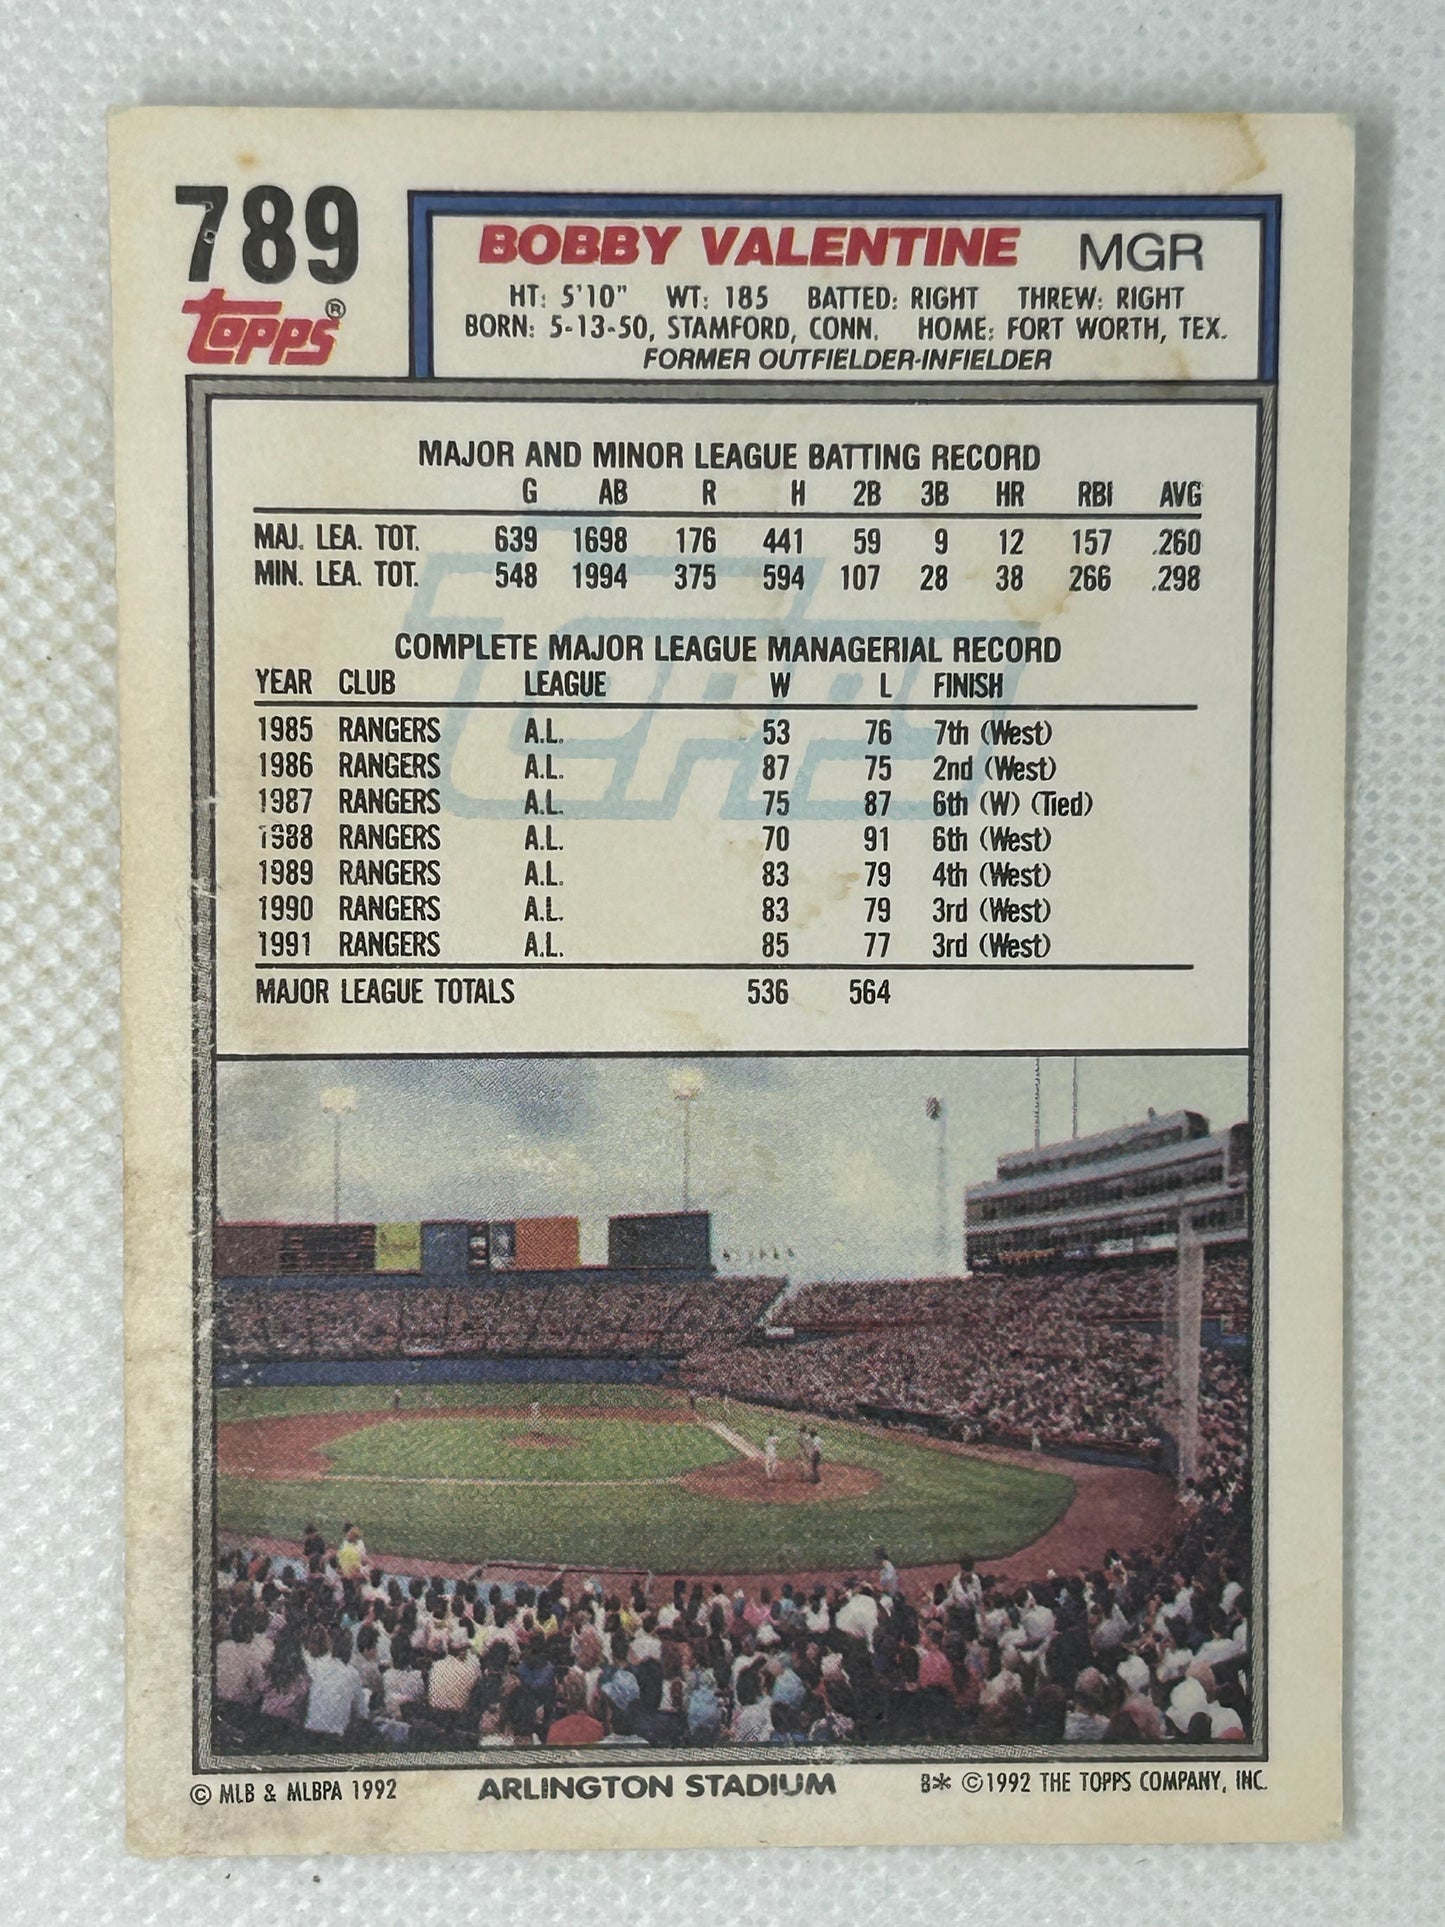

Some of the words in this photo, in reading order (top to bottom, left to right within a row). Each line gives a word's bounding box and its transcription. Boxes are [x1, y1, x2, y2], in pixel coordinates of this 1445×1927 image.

[175, 184, 359, 285] 789
[478, 223, 683, 266] BOBBY
[701, 226, 1022, 267] VALENTINE
[1079, 232, 1204, 272] MGR
[509, 283, 546, 308] HT:
[665, 284, 709, 310] WT:
[725, 285, 768, 310] 185
[807, 285, 898, 311] BATTED:
[911, 286, 979, 311] RIGHT
[1017, 286, 1103, 311] THREW:
[1116, 285, 1185, 311] RIGHT
[465, 313, 535, 338] BORN:
[549, 314, 655, 343] 5-13-50,
[667, 315, 797, 345] STAMFORD,
[809, 315, 878, 341] CONN.
[918, 316, 994, 341] HOME:
[1007, 316, 1065, 341] FORT
[1075, 316, 1167, 345] WORTH,
[1178, 316, 1228, 340] TEX.
[643, 347, 751, 370] FORMER
[758, 347, 1053, 371] OUTFIELDER-INFIELDER
[418, 439, 515, 468] MAJOR
[525, 441, 582, 468] AND
[593, 441, 684, 470] MINOR
[695, 442, 798, 470] LEAGUE
[808, 443, 921, 471] BATTING
[931, 443, 1041, 471] RECORD
[522, 477, 538, 505] G
[598, 478, 628, 506] AB
[702, 478, 717, 506] R
[791, 479, 806, 507] H
[853, 479, 882, 507] 2B
[920, 480, 950, 507] 3B
[996, 480, 1025, 508] HR
[1078, 480, 1113, 508] RBI
[1159, 480, 1202, 508] AVG
[254, 522, 304, 551] MAJ.
[316, 523, 363, 551] LEA.
[374, 523, 420, 552] TOT.
[494, 524, 538, 553] 639
[573, 525, 628, 554] 1698
[676, 526, 717, 554] 176
[762, 527, 803, 555] 441
[854, 527, 881, 555] 59
[934, 527, 949, 555] 9
[999, 528, 1025, 555] 12
[1072, 528, 1112, 556] 157
[1152, 528, 1202, 556] .260
[254, 559, 304, 587] MIN.
[316, 559, 362, 587] LEA.
[373, 560, 419, 588] TOT.
[495, 561, 538, 589] 548
[572, 561, 628, 590] 1994
[674, 563, 717, 591] 375
[763, 563, 805, 591] 594
[840, 563, 881, 591] 107
[920, 564, 948, 592] 28
[995, 564, 1024, 592] 38
[1068, 564, 1112, 592] 266
[1151, 564, 1201, 592] .298
[394, 632, 538, 661] COMPLETE
[548, 633, 644, 662] MAJOR
[654, 634, 757, 663] LEAGUE
[767, 635, 943, 663] MANAGERIAL
[953, 636, 1062, 664] RECORD
[254, 667, 313, 695] YEAR
[338, 668, 396, 696] CLUB
[524, 669, 607, 698] LEAGUE
[769, 671, 791, 699] W
[880, 672, 893, 699] L
[933, 672, 1004, 699] FINISH
[258, 715, 314, 743] 1985
[338, 716, 442, 744] RANGERS
[524, 717, 564, 745] A.L.
[762, 718, 791, 746] 53
[864, 718, 893, 746] 76
[934, 719, 969, 746] 7th
[980, 719, 1053, 746] (West)
[259, 751, 314, 779] 1986
[339, 751, 441, 780] RANGERS
[524, 753, 564, 780] A.L.
[762, 753, 790, 781] 87
[864, 754, 892, 782] 75
[932, 754, 973, 781] 2nd
[984, 754, 1057, 782] (West)
[258, 787, 313, 814] 1987
[339, 787, 441, 815] RANGERS
[524, 788, 564, 816] A.L.
[762, 790, 790, 817] 75
[864, 790, 892, 817] 87
[932, 789, 969, 817] 6th
[979, 790, 1021, 817] (W)
[1031, 790, 1094, 817] (Tied)
[258, 823, 313, 850] 1988
[339, 823, 441, 851] RANGERS
[524, 824, 564, 851] A.L.
[762, 825, 790, 852] 70
[863, 825, 889, 852] 91
[932, 825, 968, 852] 6th
[979, 825, 1052, 853] (West)
[258, 858, 314, 886] 1989
[339, 858, 441, 886] RANGERS
[524, 860, 564, 887] A.L.
[761, 860, 790, 888] 83
[864, 861, 891, 888] 79
[932, 861, 968, 888] 4th
[979, 861, 1052, 888] (West)
[258, 894, 314, 922] 1990
[339, 894, 441, 922] RANGERS
[523, 895, 564, 922] A.L.
[761, 896, 790, 923] 83
[863, 896, 891, 923] 79
[932, 896, 968, 923] 3rd
[979, 896, 1052, 924] (West)
[257, 930, 311, 957] 1991
[339, 930, 441, 958] RANGERS
[524, 931, 564, 958] A.L.
[761, 931, 789, 958] 85
[863, 931, 891, 958] 77
[932, 932, 968, 959] 3rd
[979, 932, 1052, 959] (West)
[255, 977, 330, 1005] MAJOR
[341, 977, 424, 1005] LEAGUE
[433, 977, 515, 1005] TOTALS
[747, 978, 789, 1005] 536
[849, 978, 891, 1005] 564
[219, 1782, 255, 1805] MLB
[263, 1783, 277, 1803] &
[286, 1780, 343, 1802] MLBPA
[352, 1778, 397, 1800] 1992
[477, 1774, 674, 1801] ARLINGTON
[685, 1772, 837, 1798] STADIUM
[1039, 1771, 1071, 1793] THE
[1079, 1770, 1132, 1793] TOPPS
[1139, 1770, 1227, 1794] COMPANY,
[1235, 1769, 1268, 1791] INC.
